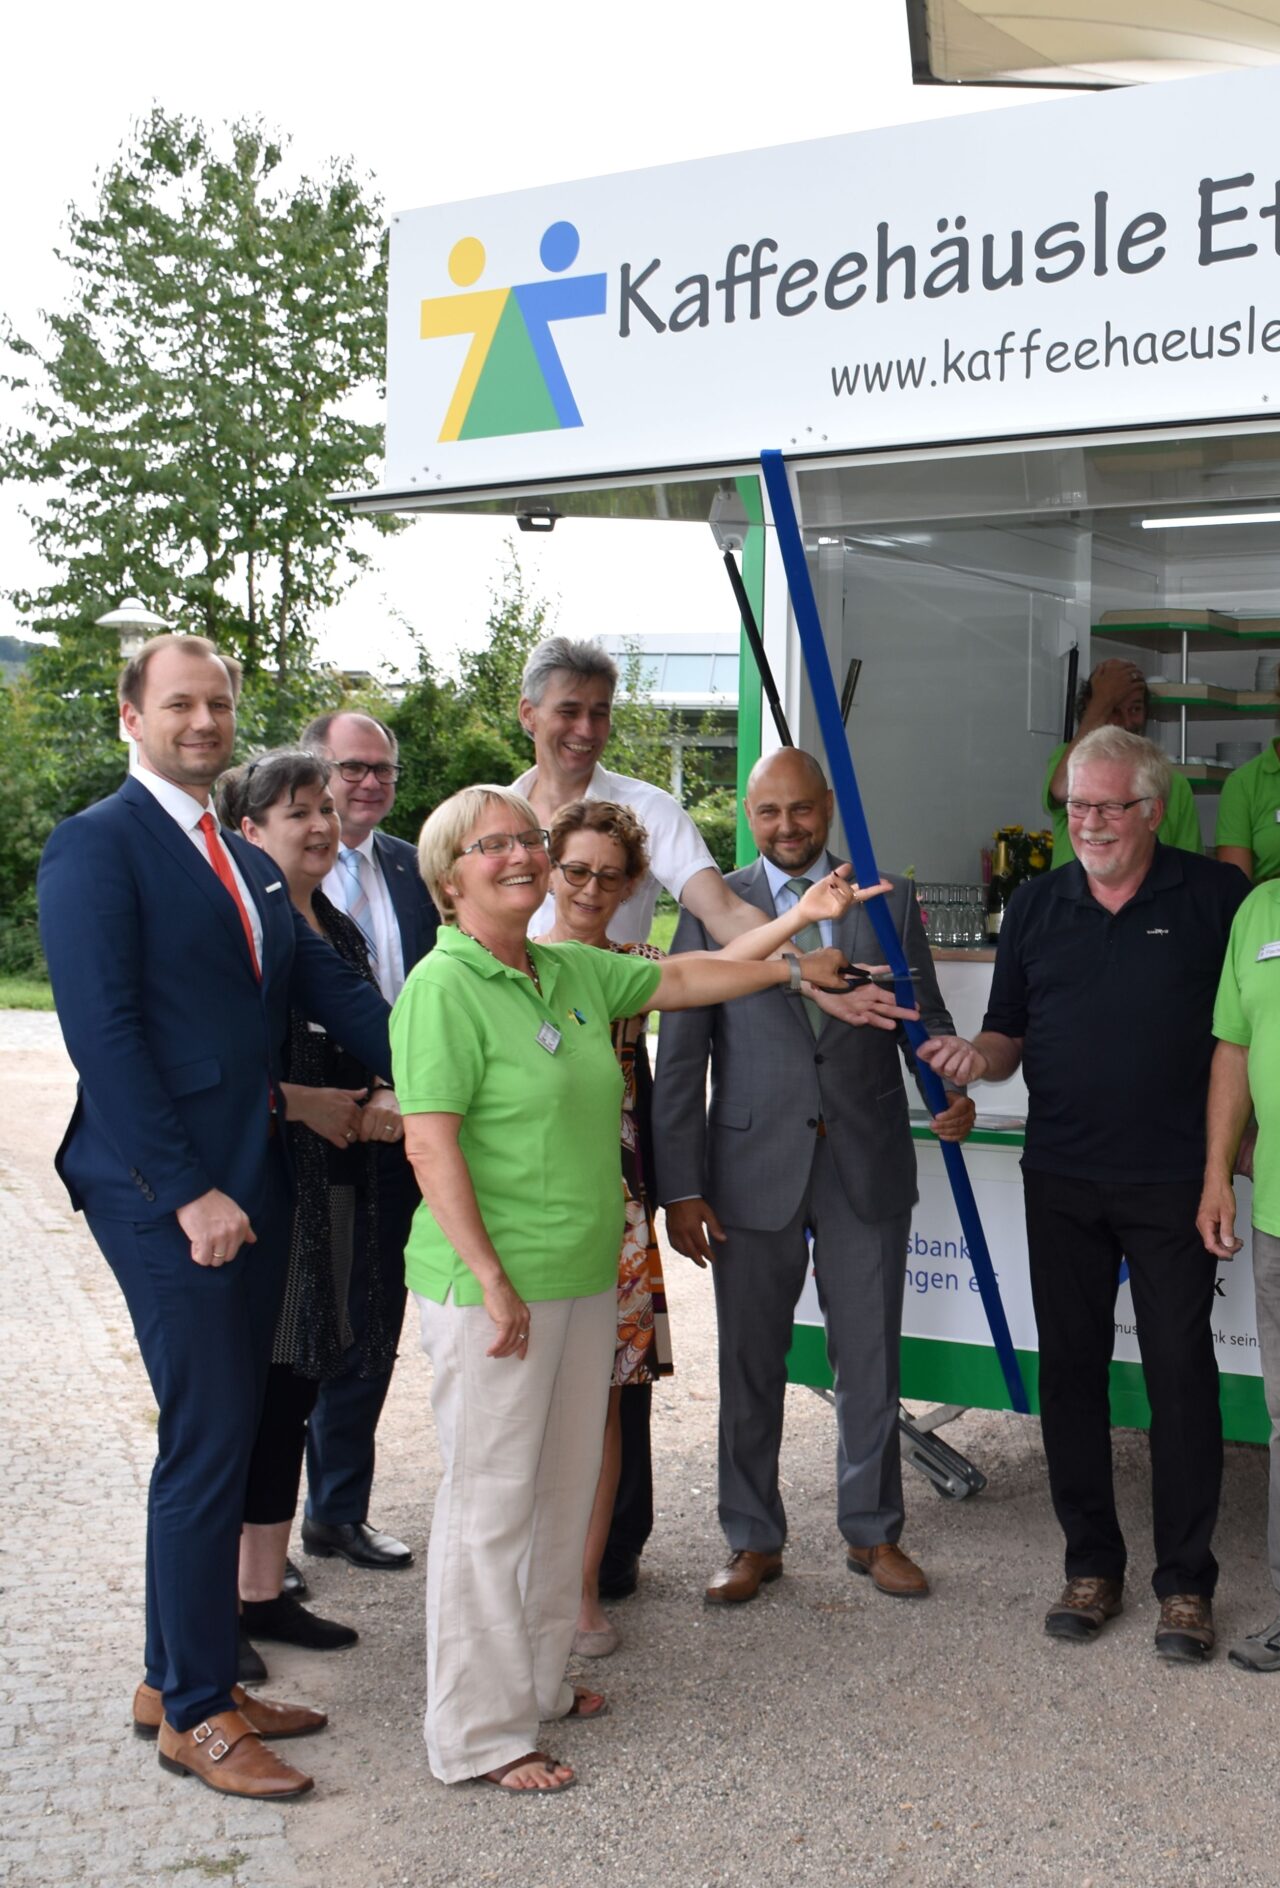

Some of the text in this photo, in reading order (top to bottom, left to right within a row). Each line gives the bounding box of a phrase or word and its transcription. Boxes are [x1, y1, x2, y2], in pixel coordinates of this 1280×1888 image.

[618, 190, 1167, 338] Kaffeehäusle
[906, 1232, 971, 1260] sbank
[905, 1269, 959, 1294] ngen
